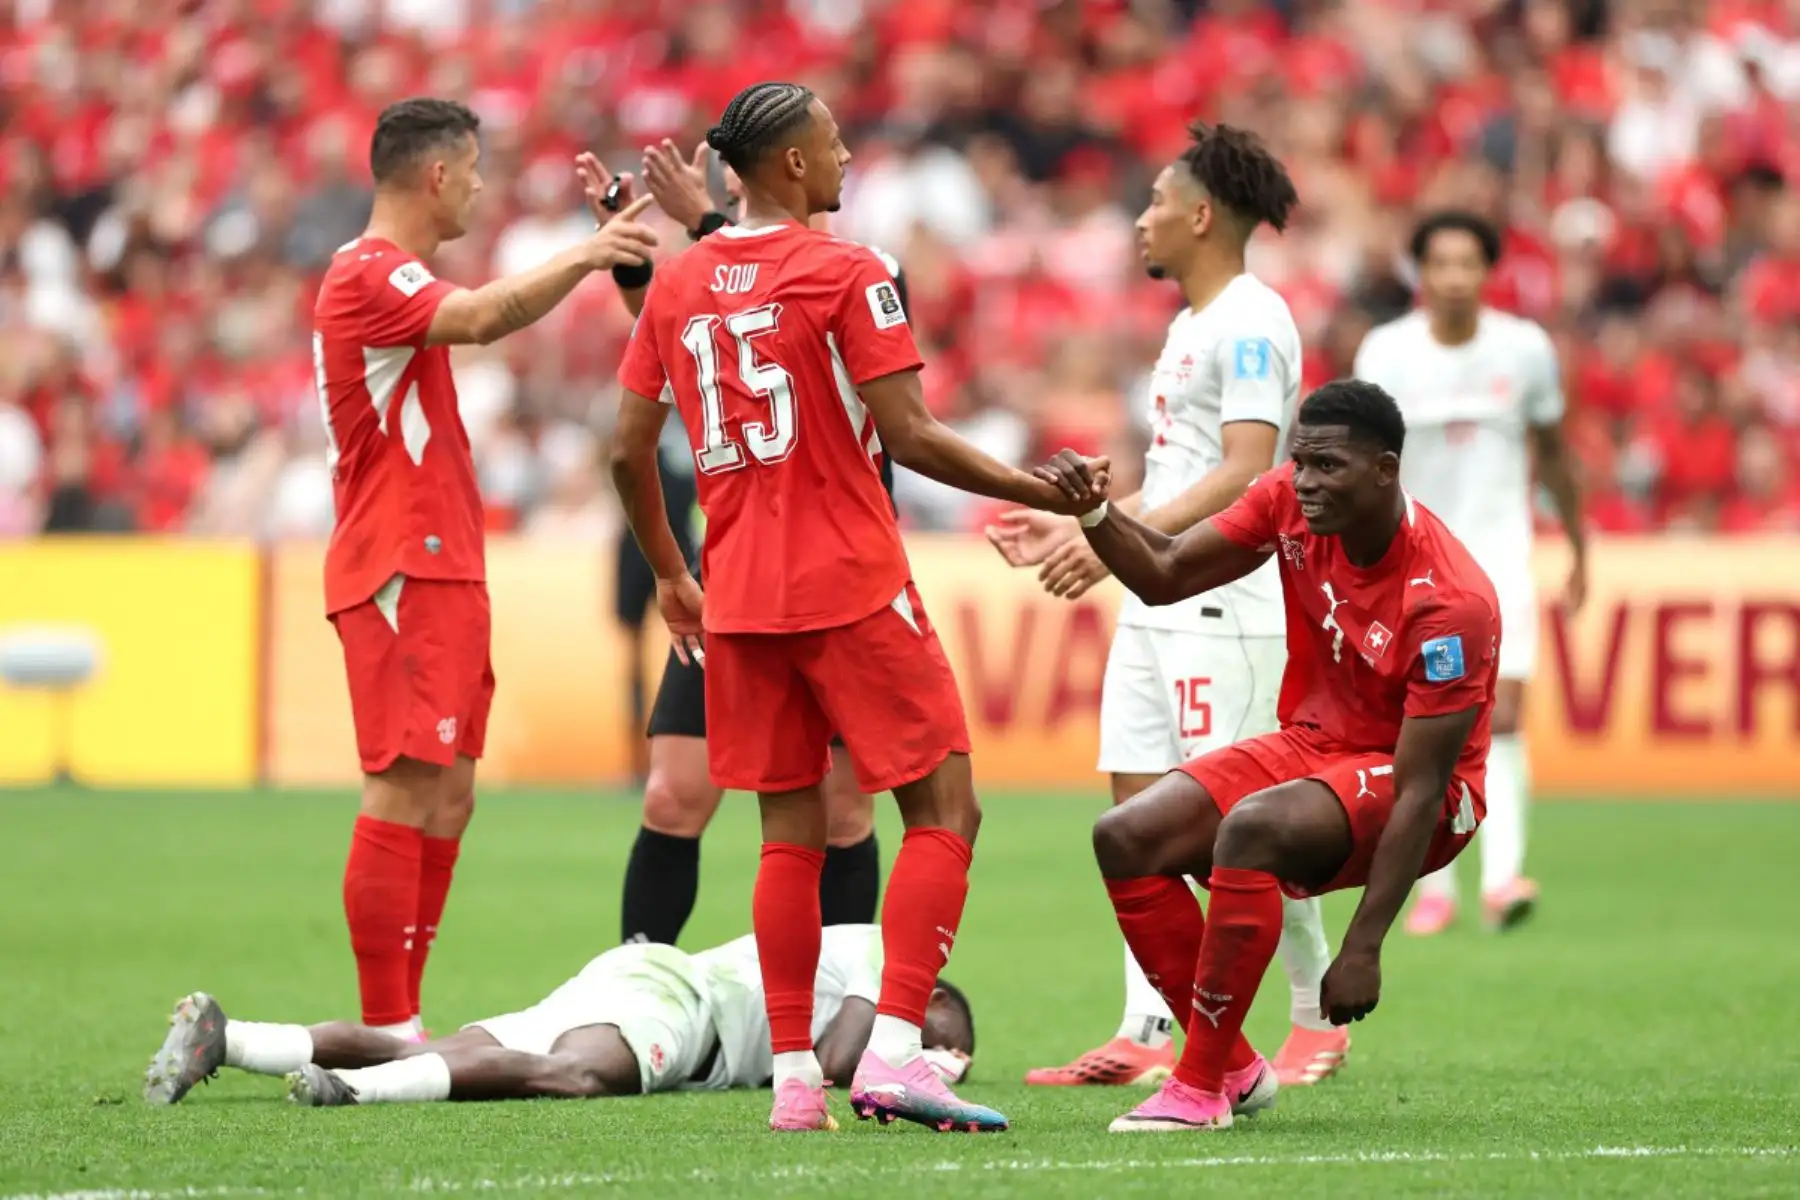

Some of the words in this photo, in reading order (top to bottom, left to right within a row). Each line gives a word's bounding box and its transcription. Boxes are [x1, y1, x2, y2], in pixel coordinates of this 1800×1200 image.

[710, 263, 759, 294] SOW
[681, 302, 798, 476] 15
[1322, 613, 1344, 663] 7
